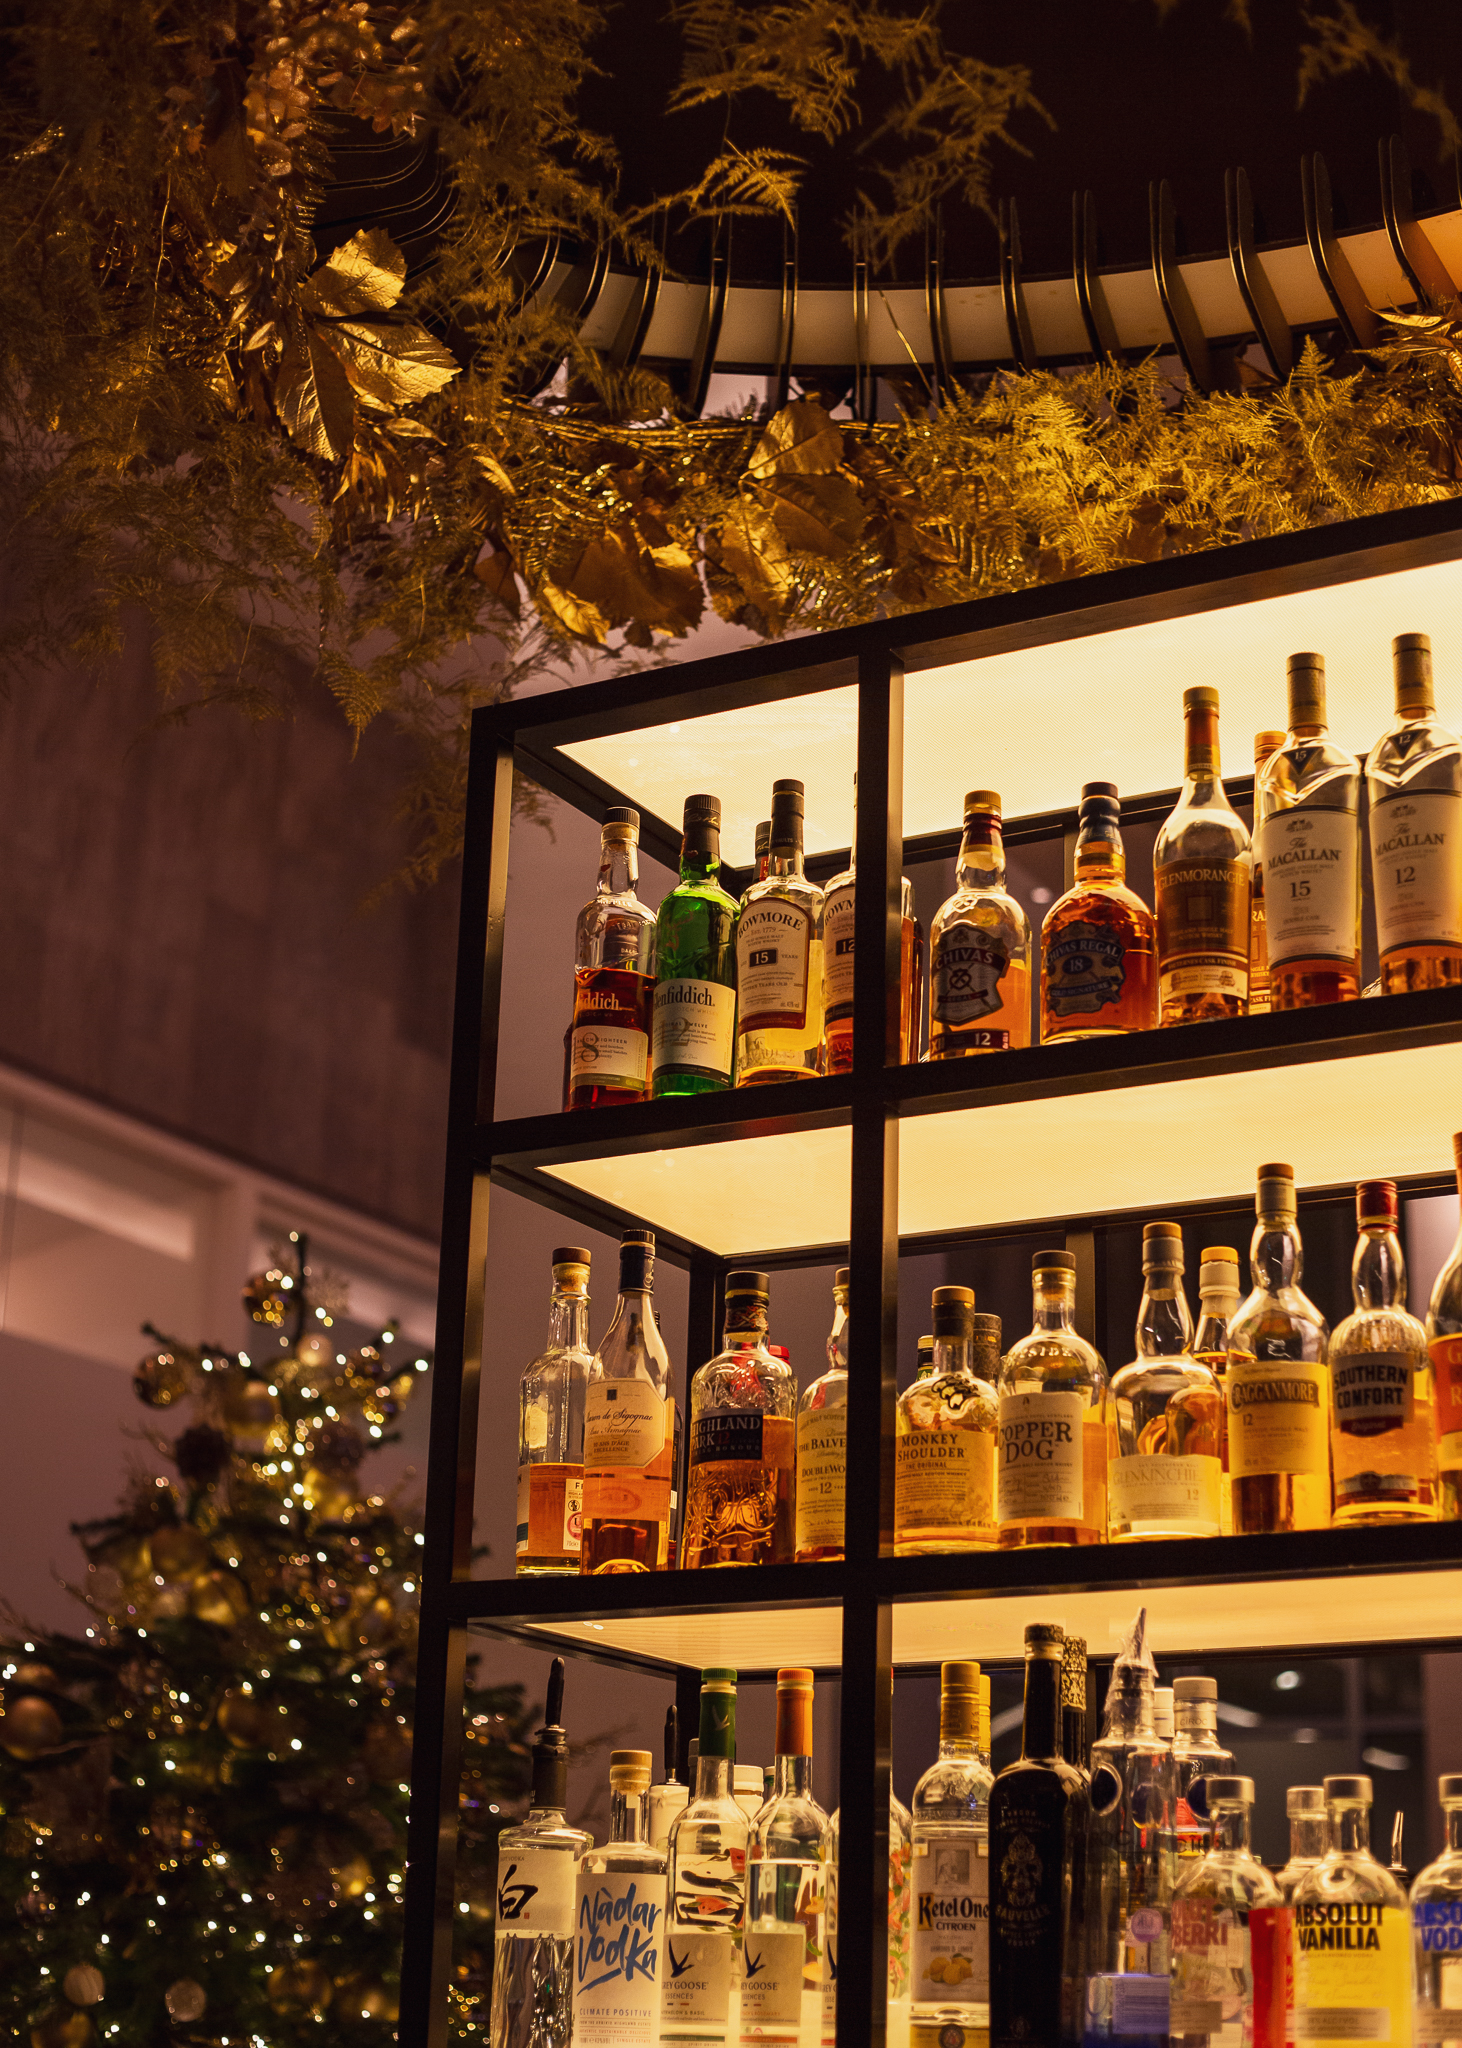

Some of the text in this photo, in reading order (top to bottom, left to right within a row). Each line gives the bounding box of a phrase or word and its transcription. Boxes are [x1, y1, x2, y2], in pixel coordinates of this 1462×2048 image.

[1399, 734, 1411, 744] 12
[1294, 751, 1307, 761] 15
[1375, 833, 1445, 856] MACALLAN
[1268, 848, 1340, 872] MACALLAN
[1159, 868, 1245, 891] GLENMORANGIE
[1395, 866, 1416, 886] 12
[1290, 880, 1311, 898] 15
[841, 940, 855, 954] 12
[1080, 940, 1119, 957] REGAL
[755, 951, 769, 965] 15
[936, 948, 994, 969] CHIVAS
[1069, 958, 1084, 972] 18
[974, 1032, 991, 1046] 12
[1334, 1364, 1409, 1390] SOUTHERN
[1337, 1387, 1404, 1410] COMFORT
[1242, 1413, 1253, 1426] 12
[811, 1438, 847, 1450] BALVE
[901, 1433, 958, 1448] MONKEY
[999, 1421, 1073, 1450] COPPER
[897, 1447, 965, 1462] SHOULDER
[1005, 1439, 1053, 1464] DOG
[801, 1464, 846, 1478] DOUBLEWO
[820, 1481, 832, 1494] 12
[1186, 1488, 1199, 1501] 12
[579, 1882, 662, 1935] Nàdar
[918, 1895, 989, 1928] Ketel One
[1295, 1902, 1384, 1927] ABSOLUT
[1414, 1901, 1462, 1927] ABSO
[935, 1921, 977, 1931] CITROEN
[1298, 1927, 1381, 1951] VANILIA
[1421, 1926, 1462, 1951] VOD
[579, 2007, 652, 2017] CLIMATE POSITIVE
